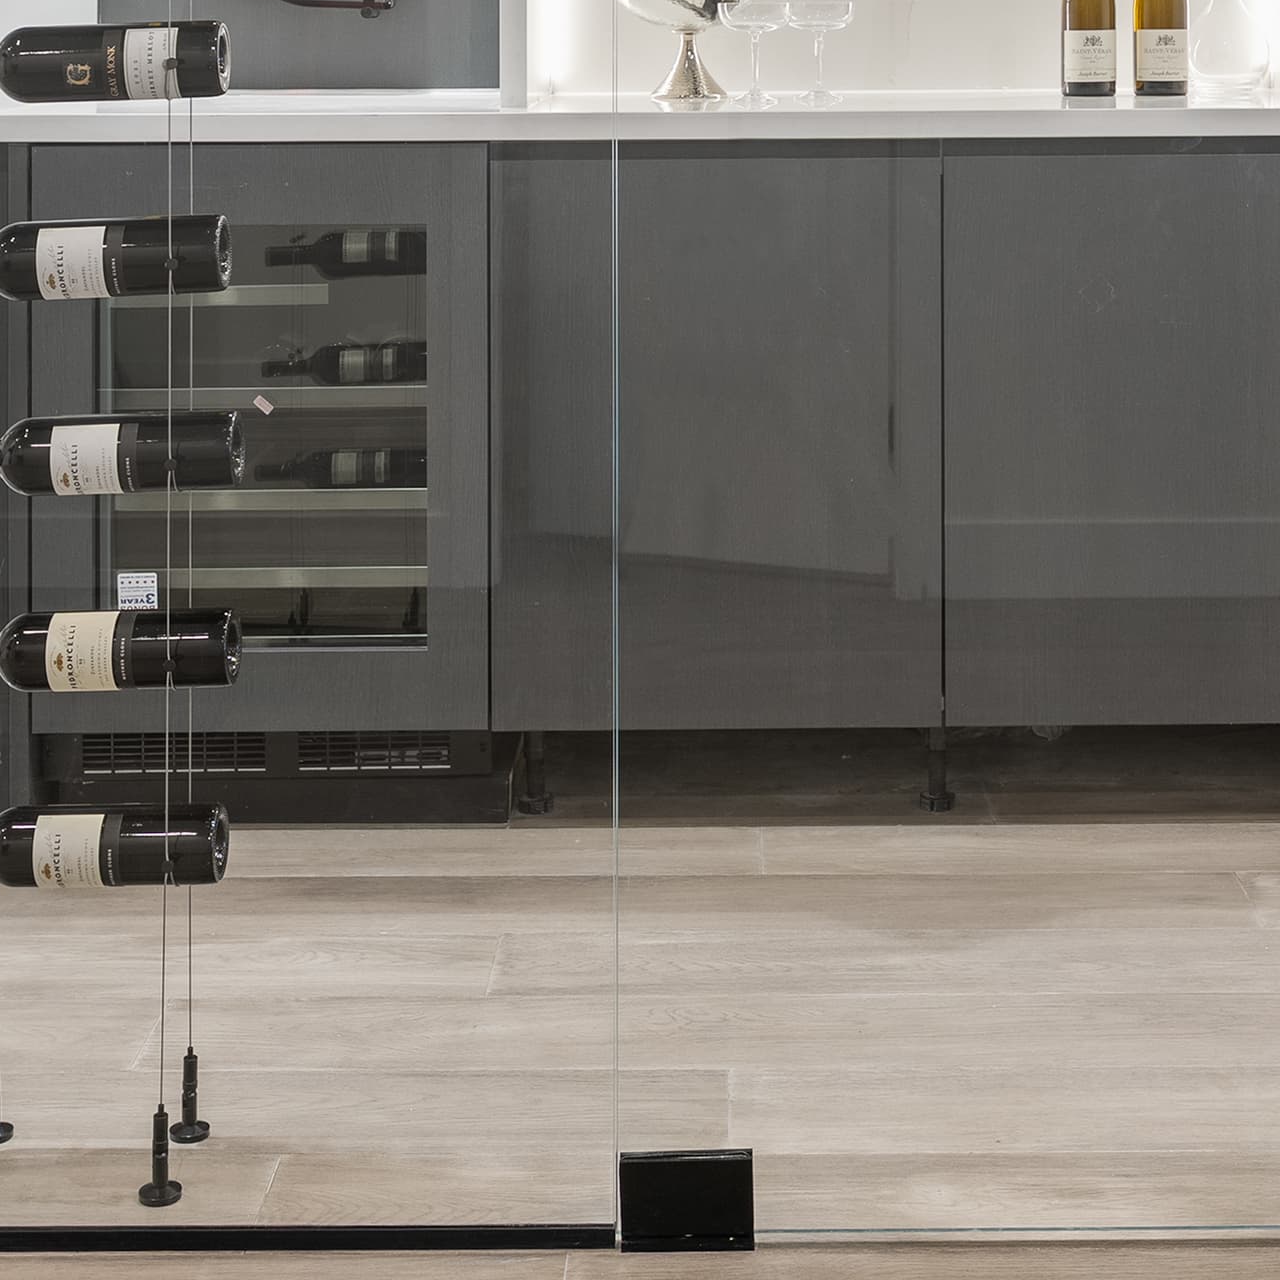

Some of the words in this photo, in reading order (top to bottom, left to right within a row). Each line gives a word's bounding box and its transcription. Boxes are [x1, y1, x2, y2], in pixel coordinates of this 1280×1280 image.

[106, 45, 116, 75] MONK
[66, 63, 92, 86] G
[108, 77, 119, 96] GRAY
[57, 245, 70, 297] DRONCELLI
[145, 593, 155, 604] 3
[53, 834, 64, 886] DRONCELLI
